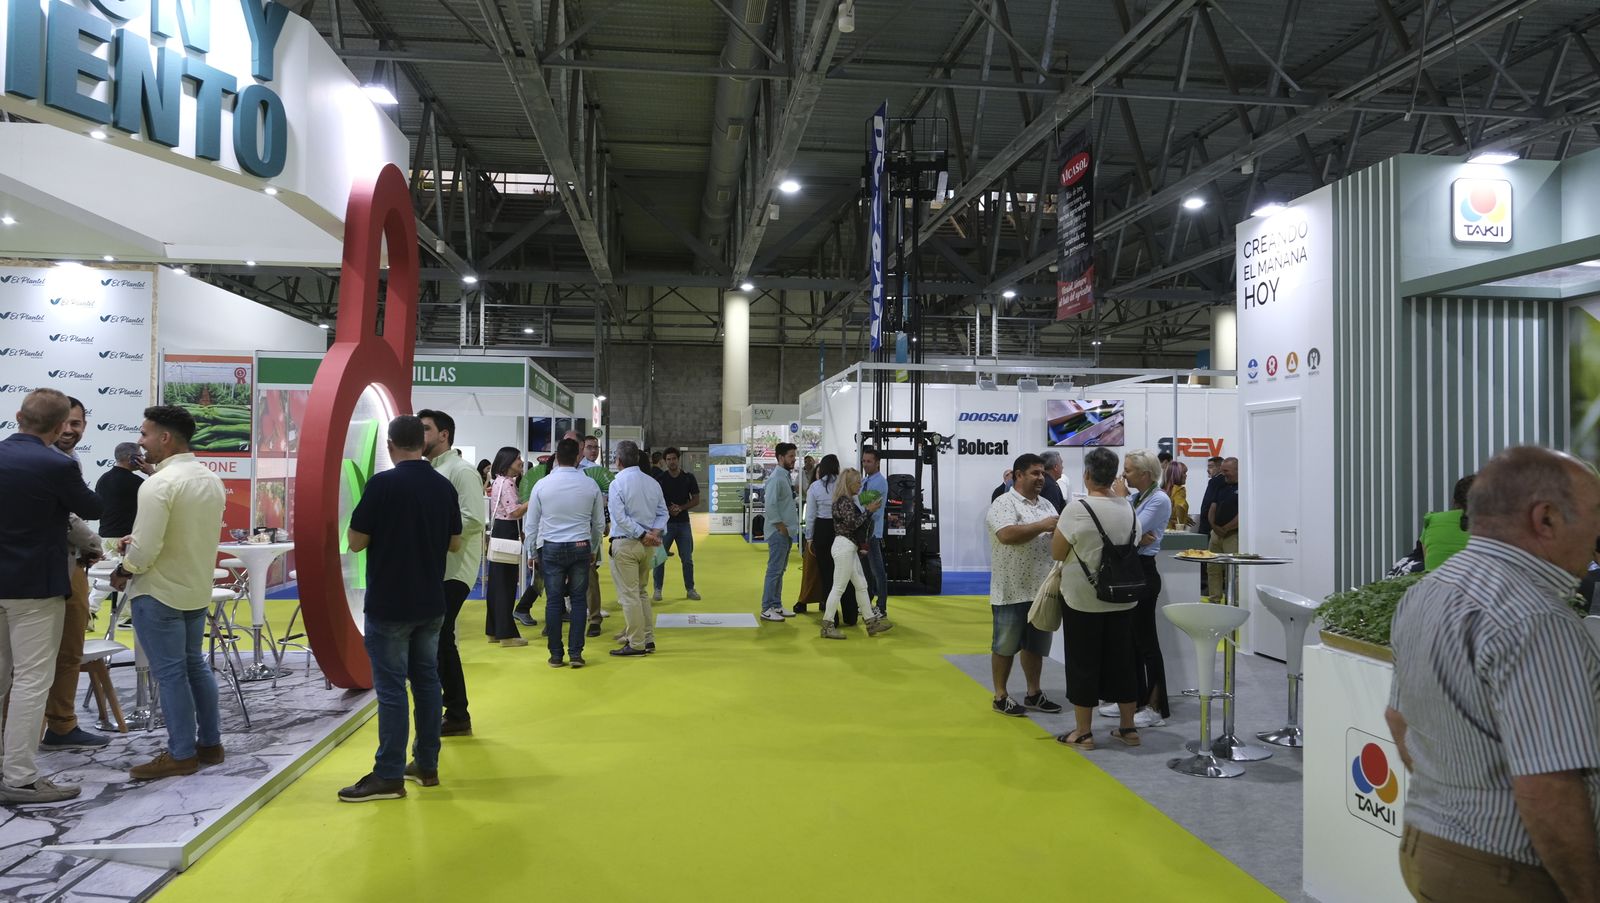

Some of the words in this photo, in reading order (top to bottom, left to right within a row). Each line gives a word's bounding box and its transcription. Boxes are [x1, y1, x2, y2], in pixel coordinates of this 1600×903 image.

[1463, 224, 1504, 237] TAKII
[1243, 221, 1309, 259] CREANDO
[1243, 265, 1257, 281] EL
[10, 276, 19, 284] El
[20, 276, 46, 285] Plantel
[111, 279, 120, 288] El
[120, 279, 146, 288] Plantel
[1244, 277, 1280, 310] HOY
[9, 312, 19, 321] El
[19, 312, 46, 321] Plantel
[110, 315, 119, 324] El
[119, 315, 145, 324] Plantel
[59, 334, 68, 343] El
[68, 334, 95, 343] Plantel
[8, 348, 18, 357] El
[18, 348, 45, 357] Plantel
[109, 351, 118, 360] El
[118, 351, 144, 360] Plantel
[58, 370, 68, 379] El
[67, 370, 94, 379] Plantel
[108, 387, 117, 396] El
[117, 387, 143, 396] Plantel
[958, 412, 1019, 423] DOOSAN
[107, 423, 116, 432] El
[957, 438, 1009, 456] Bobcat
[1355, 792, 1396, 826] TAKII
